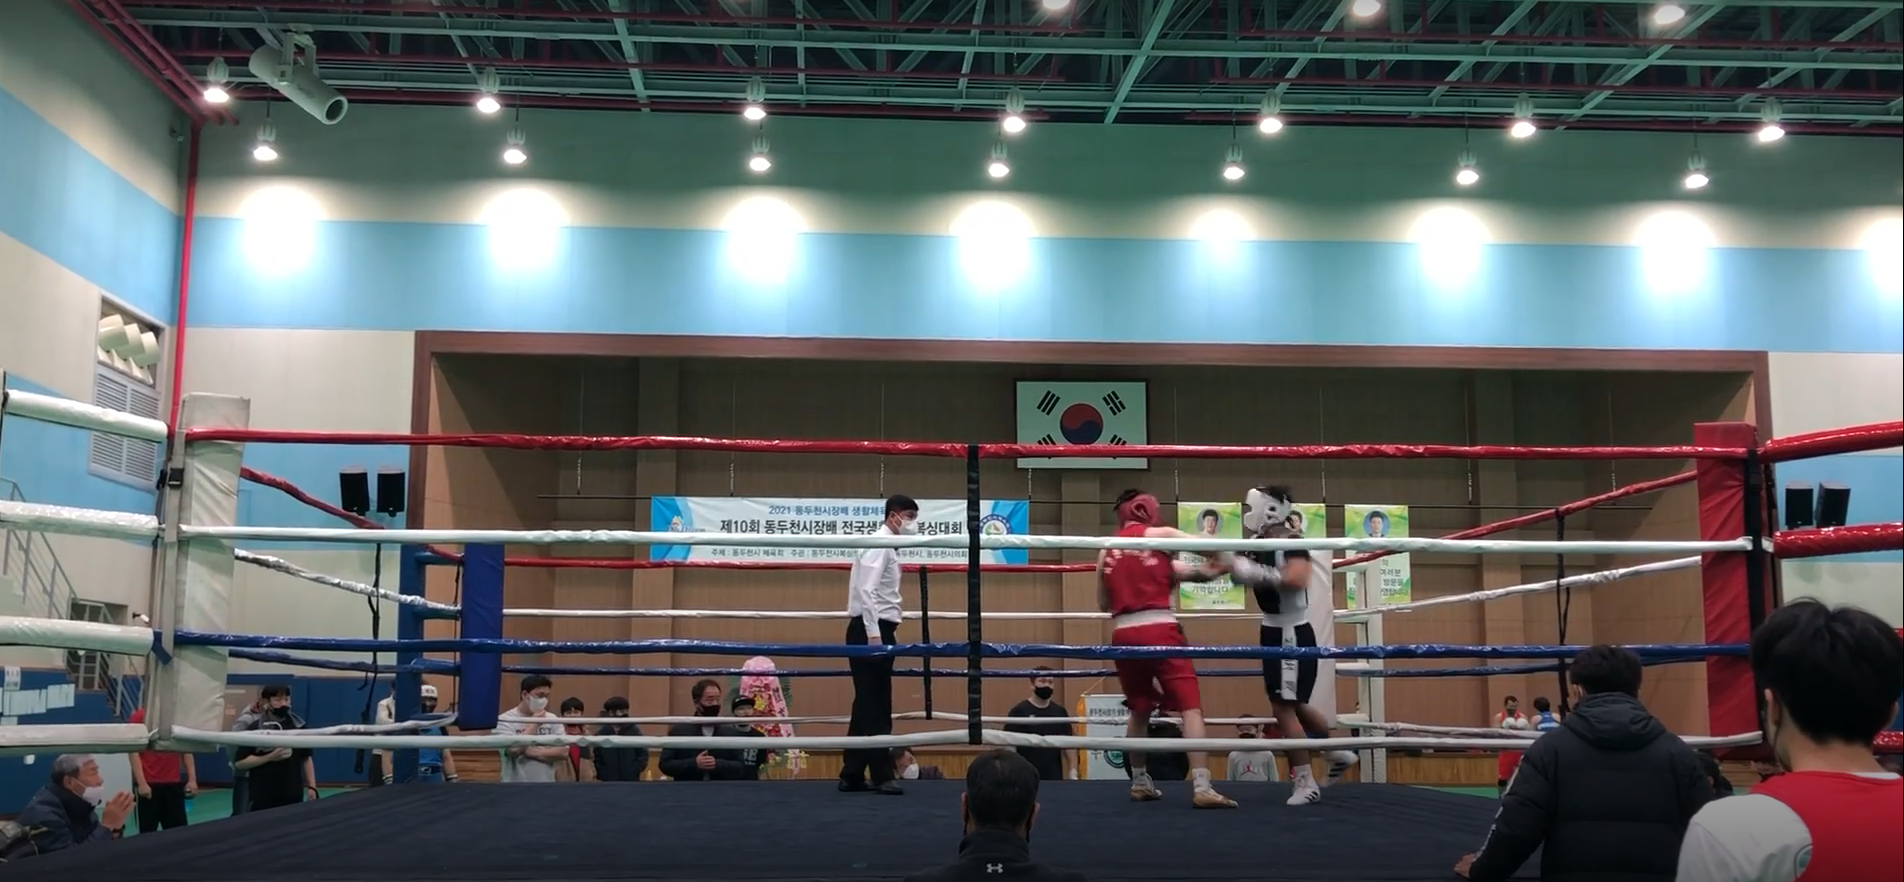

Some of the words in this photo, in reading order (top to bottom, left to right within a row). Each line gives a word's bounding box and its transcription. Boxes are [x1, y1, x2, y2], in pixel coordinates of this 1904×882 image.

[769, 505, 791, 515] 2021
[795, 505, 849, 516] 동두천시장배
[720, 519, 760, 534] 제10회
[764, 520, 837, 535] 동두천시장배
